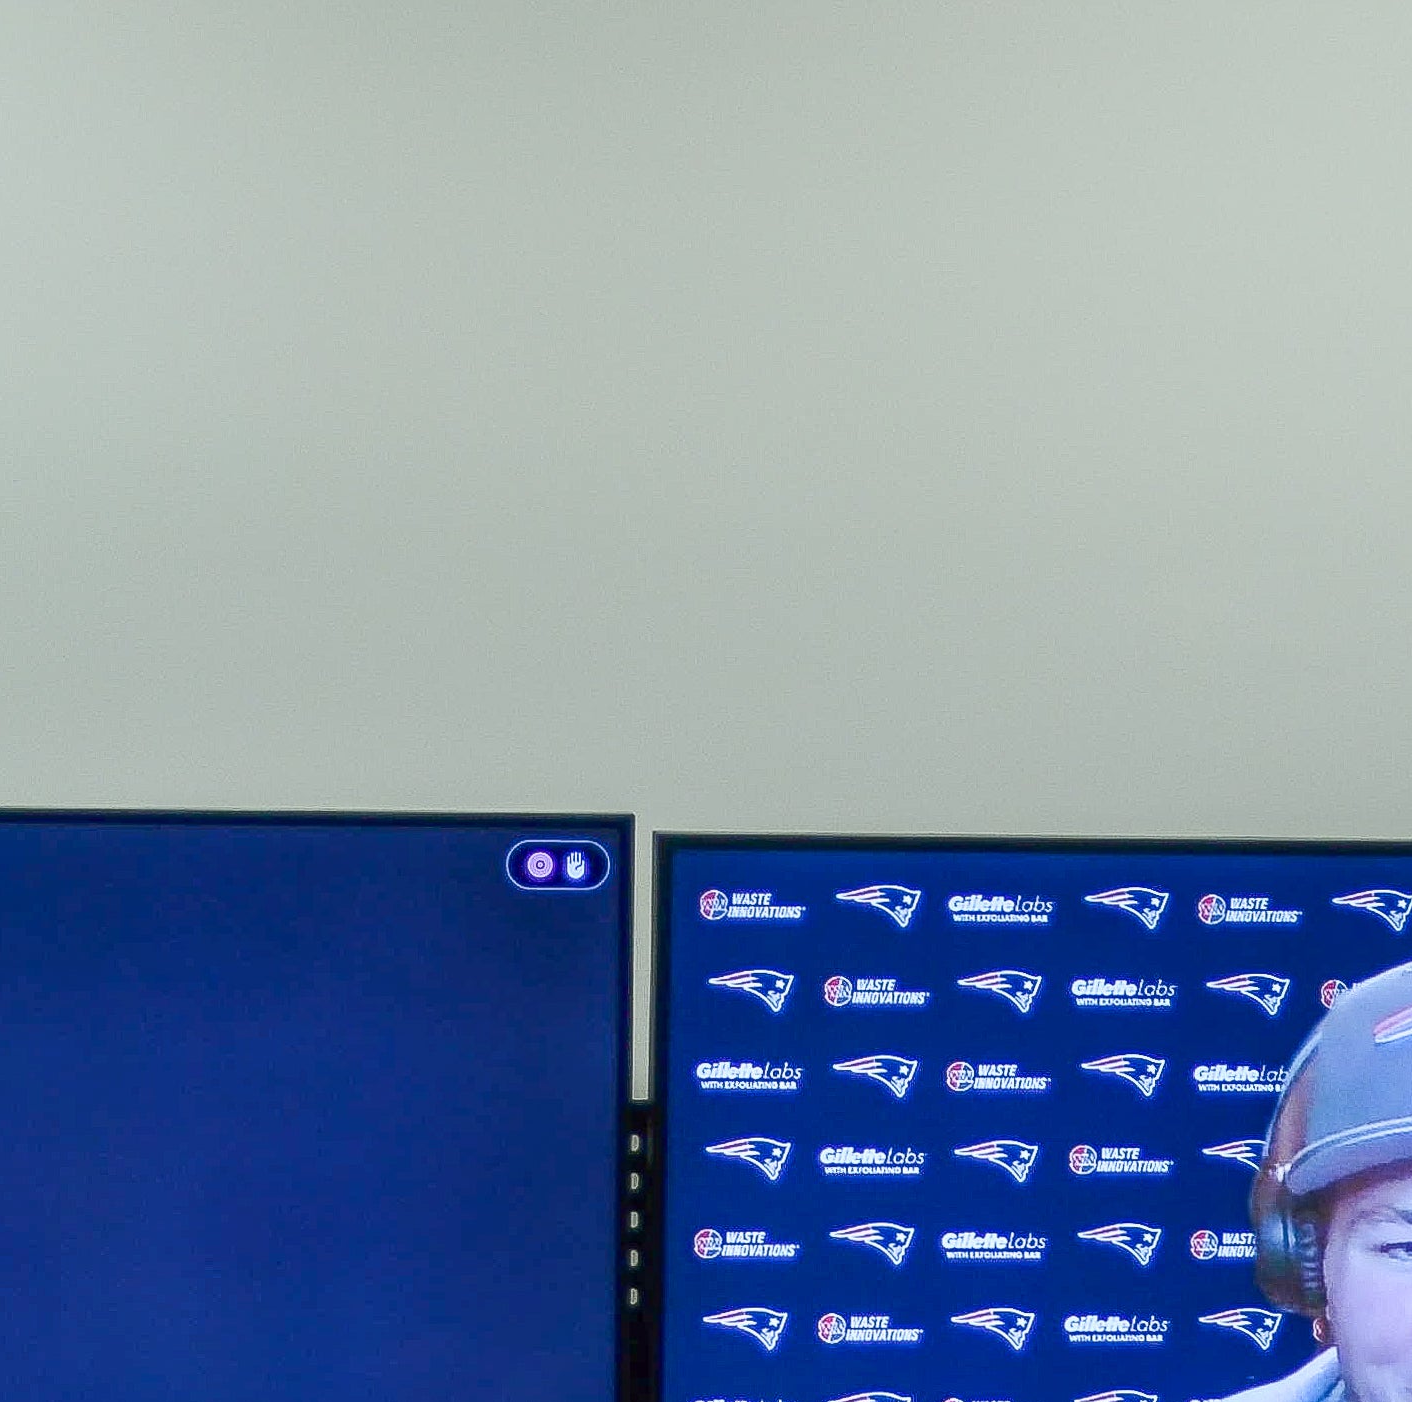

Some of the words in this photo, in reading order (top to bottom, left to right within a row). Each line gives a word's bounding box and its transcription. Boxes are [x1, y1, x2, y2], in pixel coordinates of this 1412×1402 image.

[732, 892, 772, 905] WASTE
[1229, 897, 1268, 909] WASTE
[727, 906, 801, 919] INNOVATIONS
[1225, 910, 1298, 923] INNOVATIONS
[856, 978, 896, 991] WASTE
[851, 992, 925, 1005] INNOVATIONS
[977, 1063, 1017, 1076] WASTE
[973, 1077, 1047, 1090] INNOVATIONS
[1100, 1147, 1140, 1159] WASTE
[1096, 1160, 1170, 1173] INNOVATIONS
[726, 1231, 766, 1243] WASTE
[721, 1244, 795, 1257] INNOVATIONS
[849, 1315, 889, 1328] WASTE
[845, 1329, 919, 1342] INNOVATIONS
